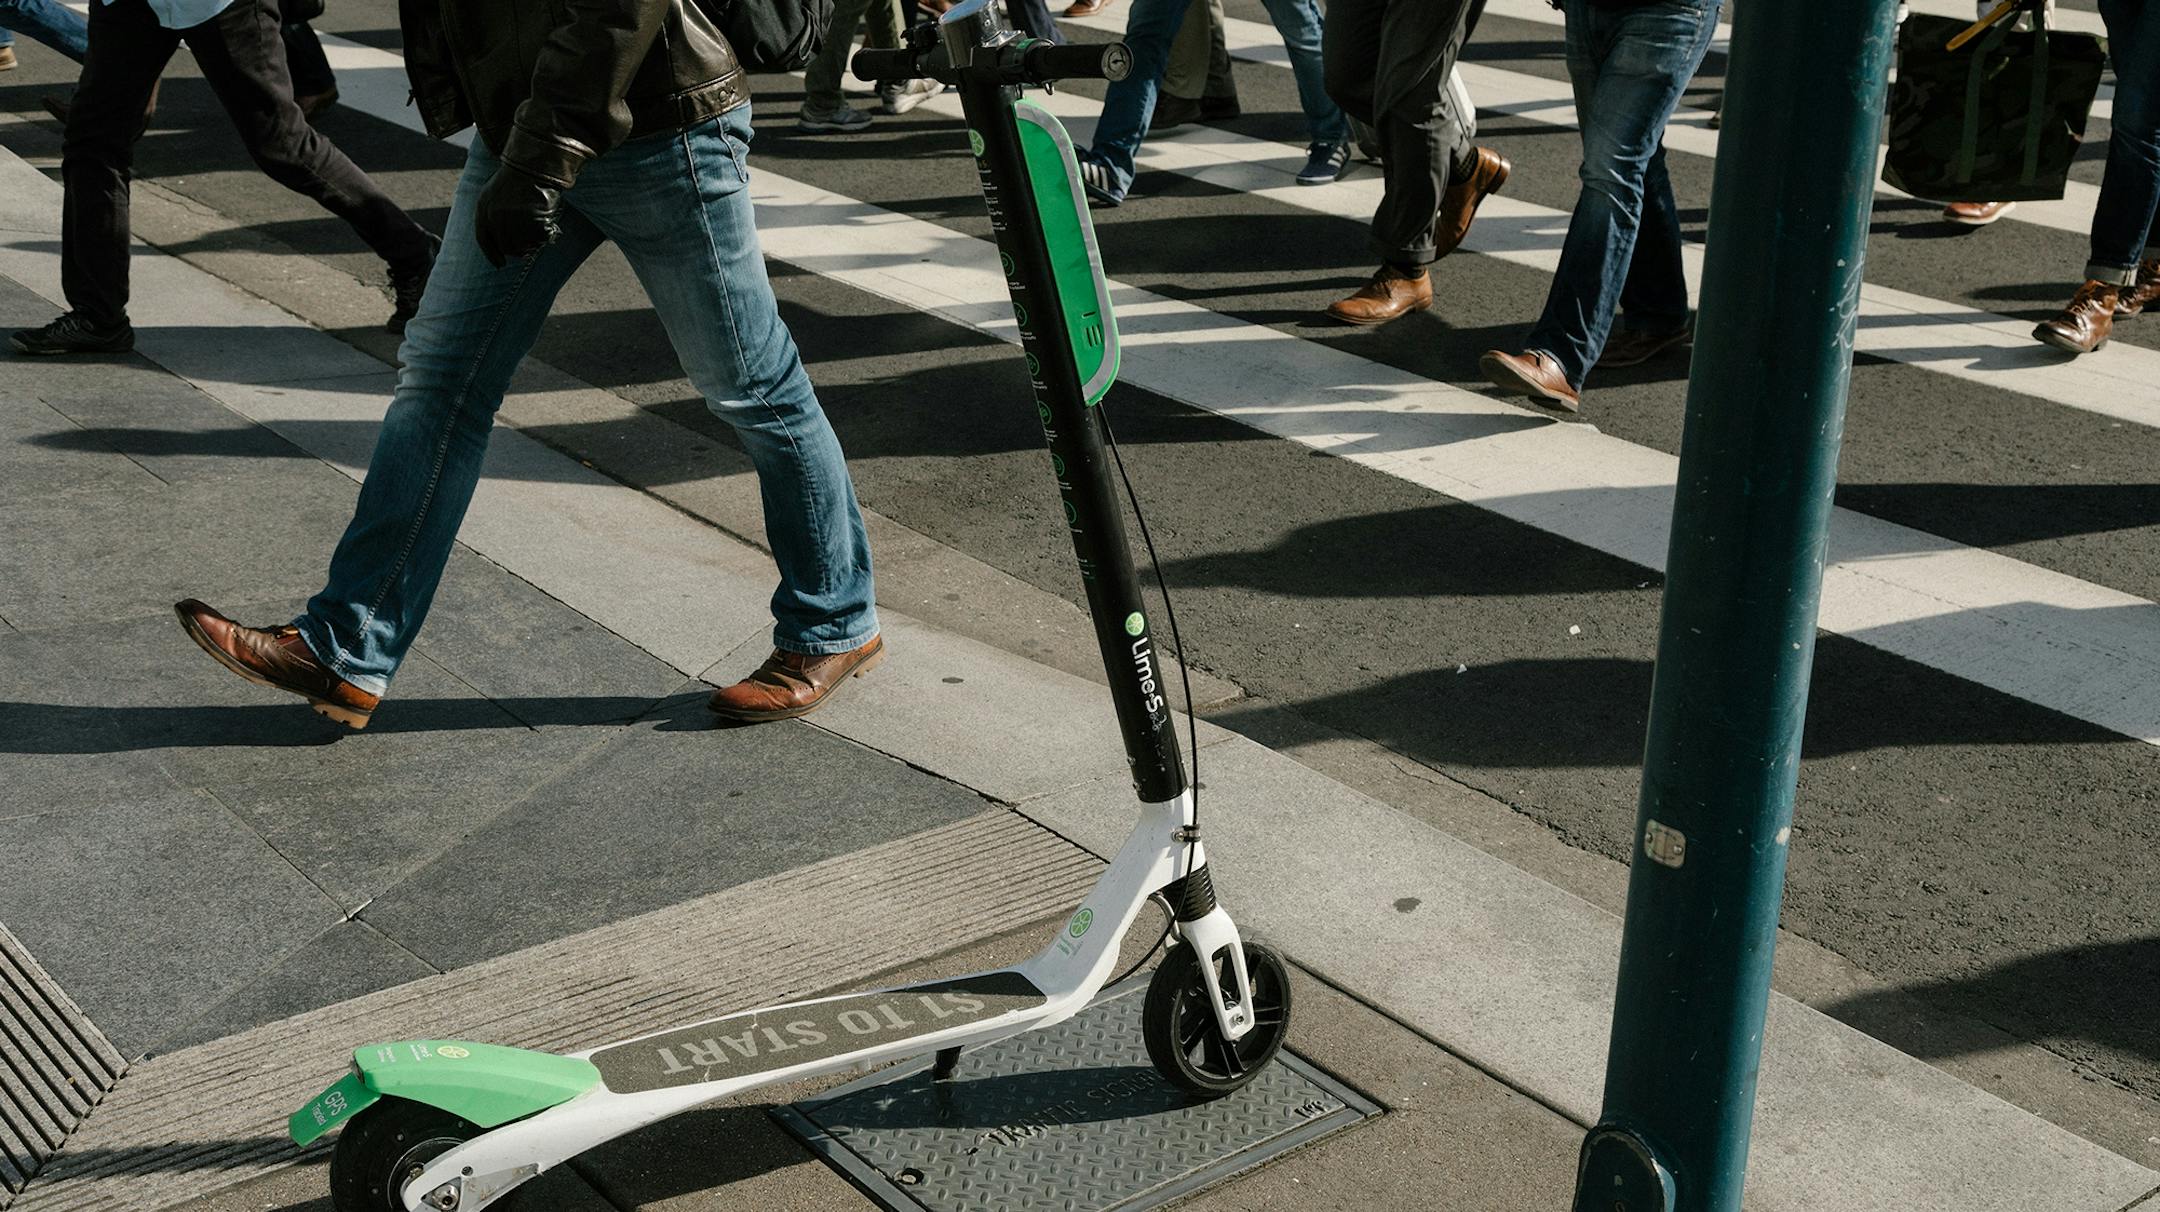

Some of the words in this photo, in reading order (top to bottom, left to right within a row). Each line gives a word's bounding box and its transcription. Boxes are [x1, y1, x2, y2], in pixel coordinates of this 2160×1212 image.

[1132, 637, 1164, 713] Lime-S
[837, 1004, 915, 1035] TO
[918, 990, 986, 1019] $1
[657, 1019, 828, 1075] START
[325, 1091, 348, 1117] GPS
